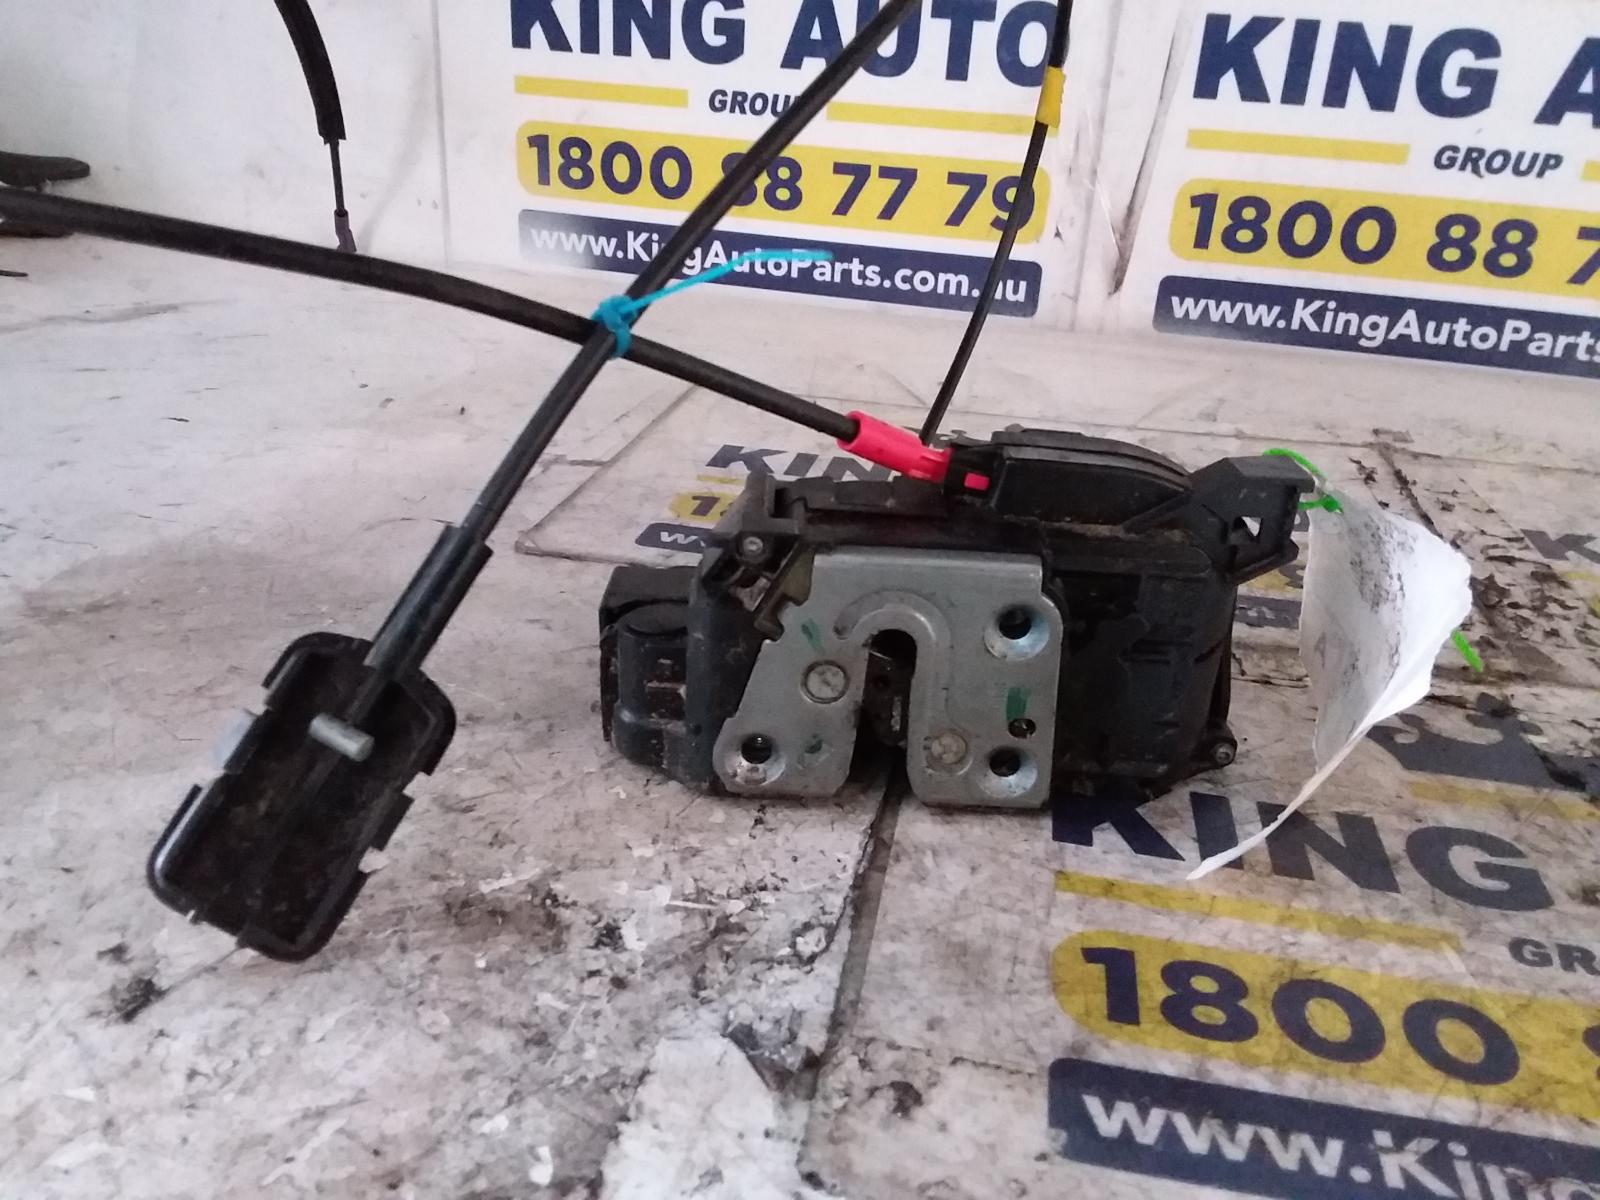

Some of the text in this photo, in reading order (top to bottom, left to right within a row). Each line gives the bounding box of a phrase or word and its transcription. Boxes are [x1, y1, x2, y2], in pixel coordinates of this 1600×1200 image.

[510, 0, 1059, 88] KING AUTO
[1193, 13, 1502, 118] KING
[709, 89, 801, 119] GROU
[528, 134, 693, 201] 1800
[832, 161, 918, 221] 77
[944, 172, 1036, 232] 79
[1433, 145, 1564, 179] GROUP
[530, 229, 1027, 303] www.KigAutoParts.com.u
[1190, 193, 1397, 265] 1800
[1426, 213, 1538, 279] 88
[705, 444, 893, 481] KIN
[1051, 790, 1555, 911] KING
[1082, 946, 1520, 1085] 1800
